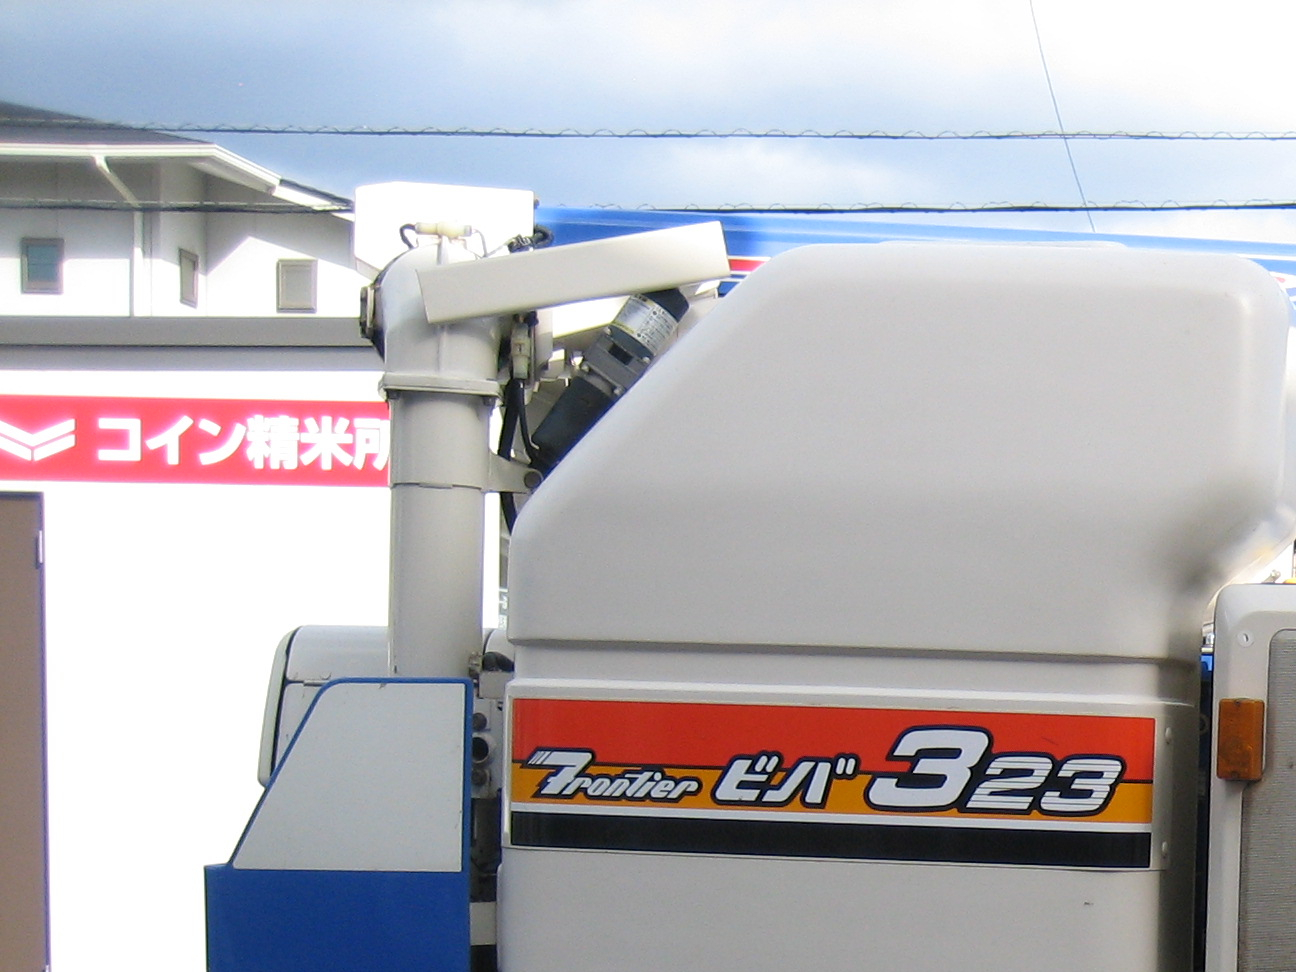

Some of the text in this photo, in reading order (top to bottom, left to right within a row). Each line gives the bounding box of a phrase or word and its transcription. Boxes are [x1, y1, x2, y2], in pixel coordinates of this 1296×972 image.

[526, 727, 1124, 814] Frontier ビバ 323
